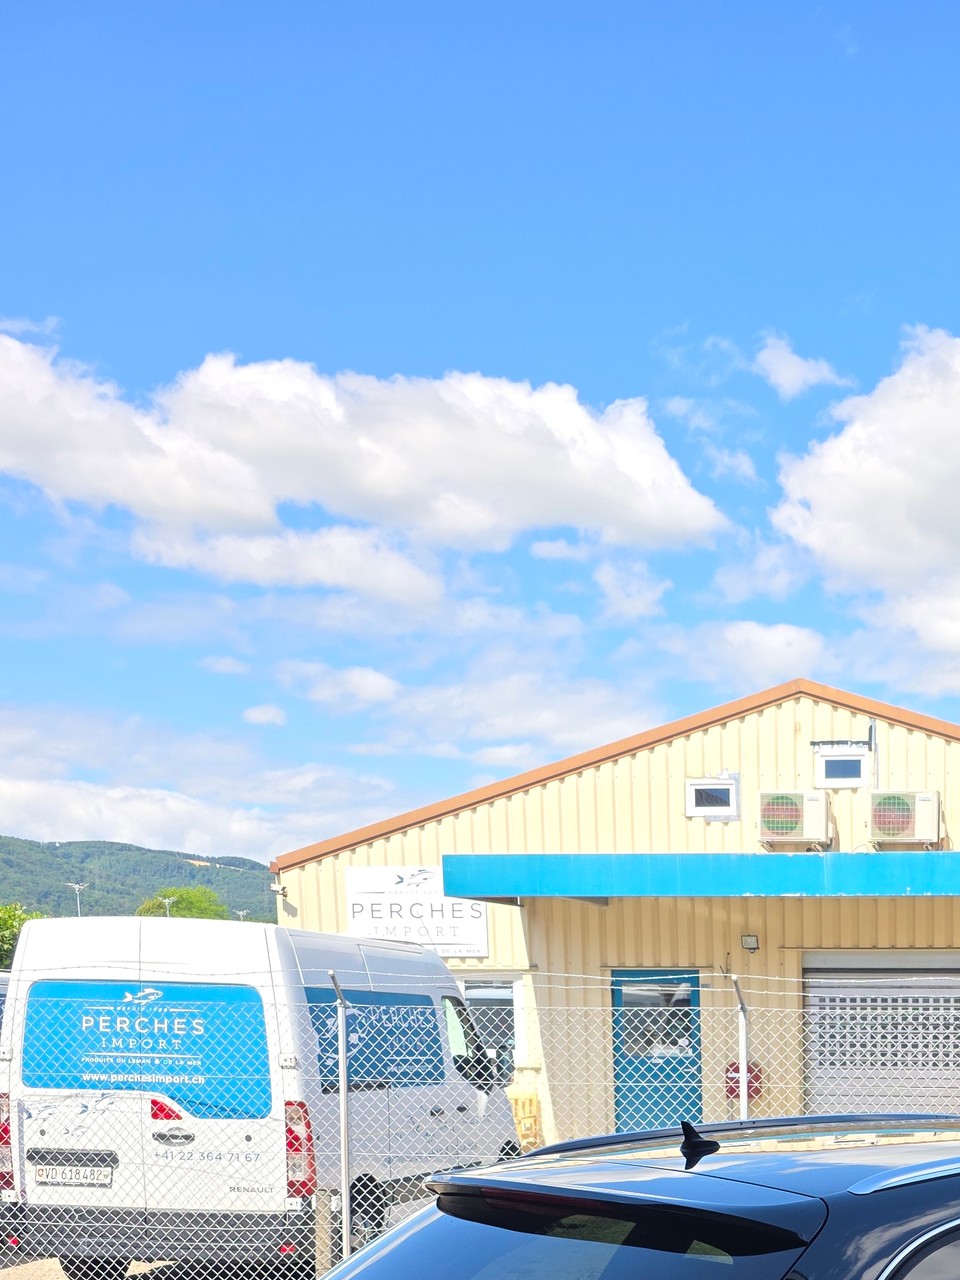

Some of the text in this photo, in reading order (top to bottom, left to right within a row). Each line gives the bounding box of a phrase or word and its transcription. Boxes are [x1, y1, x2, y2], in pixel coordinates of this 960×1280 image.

[352, 903, 482, 919] PERCHES
[373, 926, 460, 936] IMPORT
[82, 1016, 204, 1035] PERCHES
[102, 1038, 181, 1050] IMPORT
[82, 1073, 205, 1085] www.perchesimport.ch
[154, 1151, 260, 1163] +41 22 364 71 67
